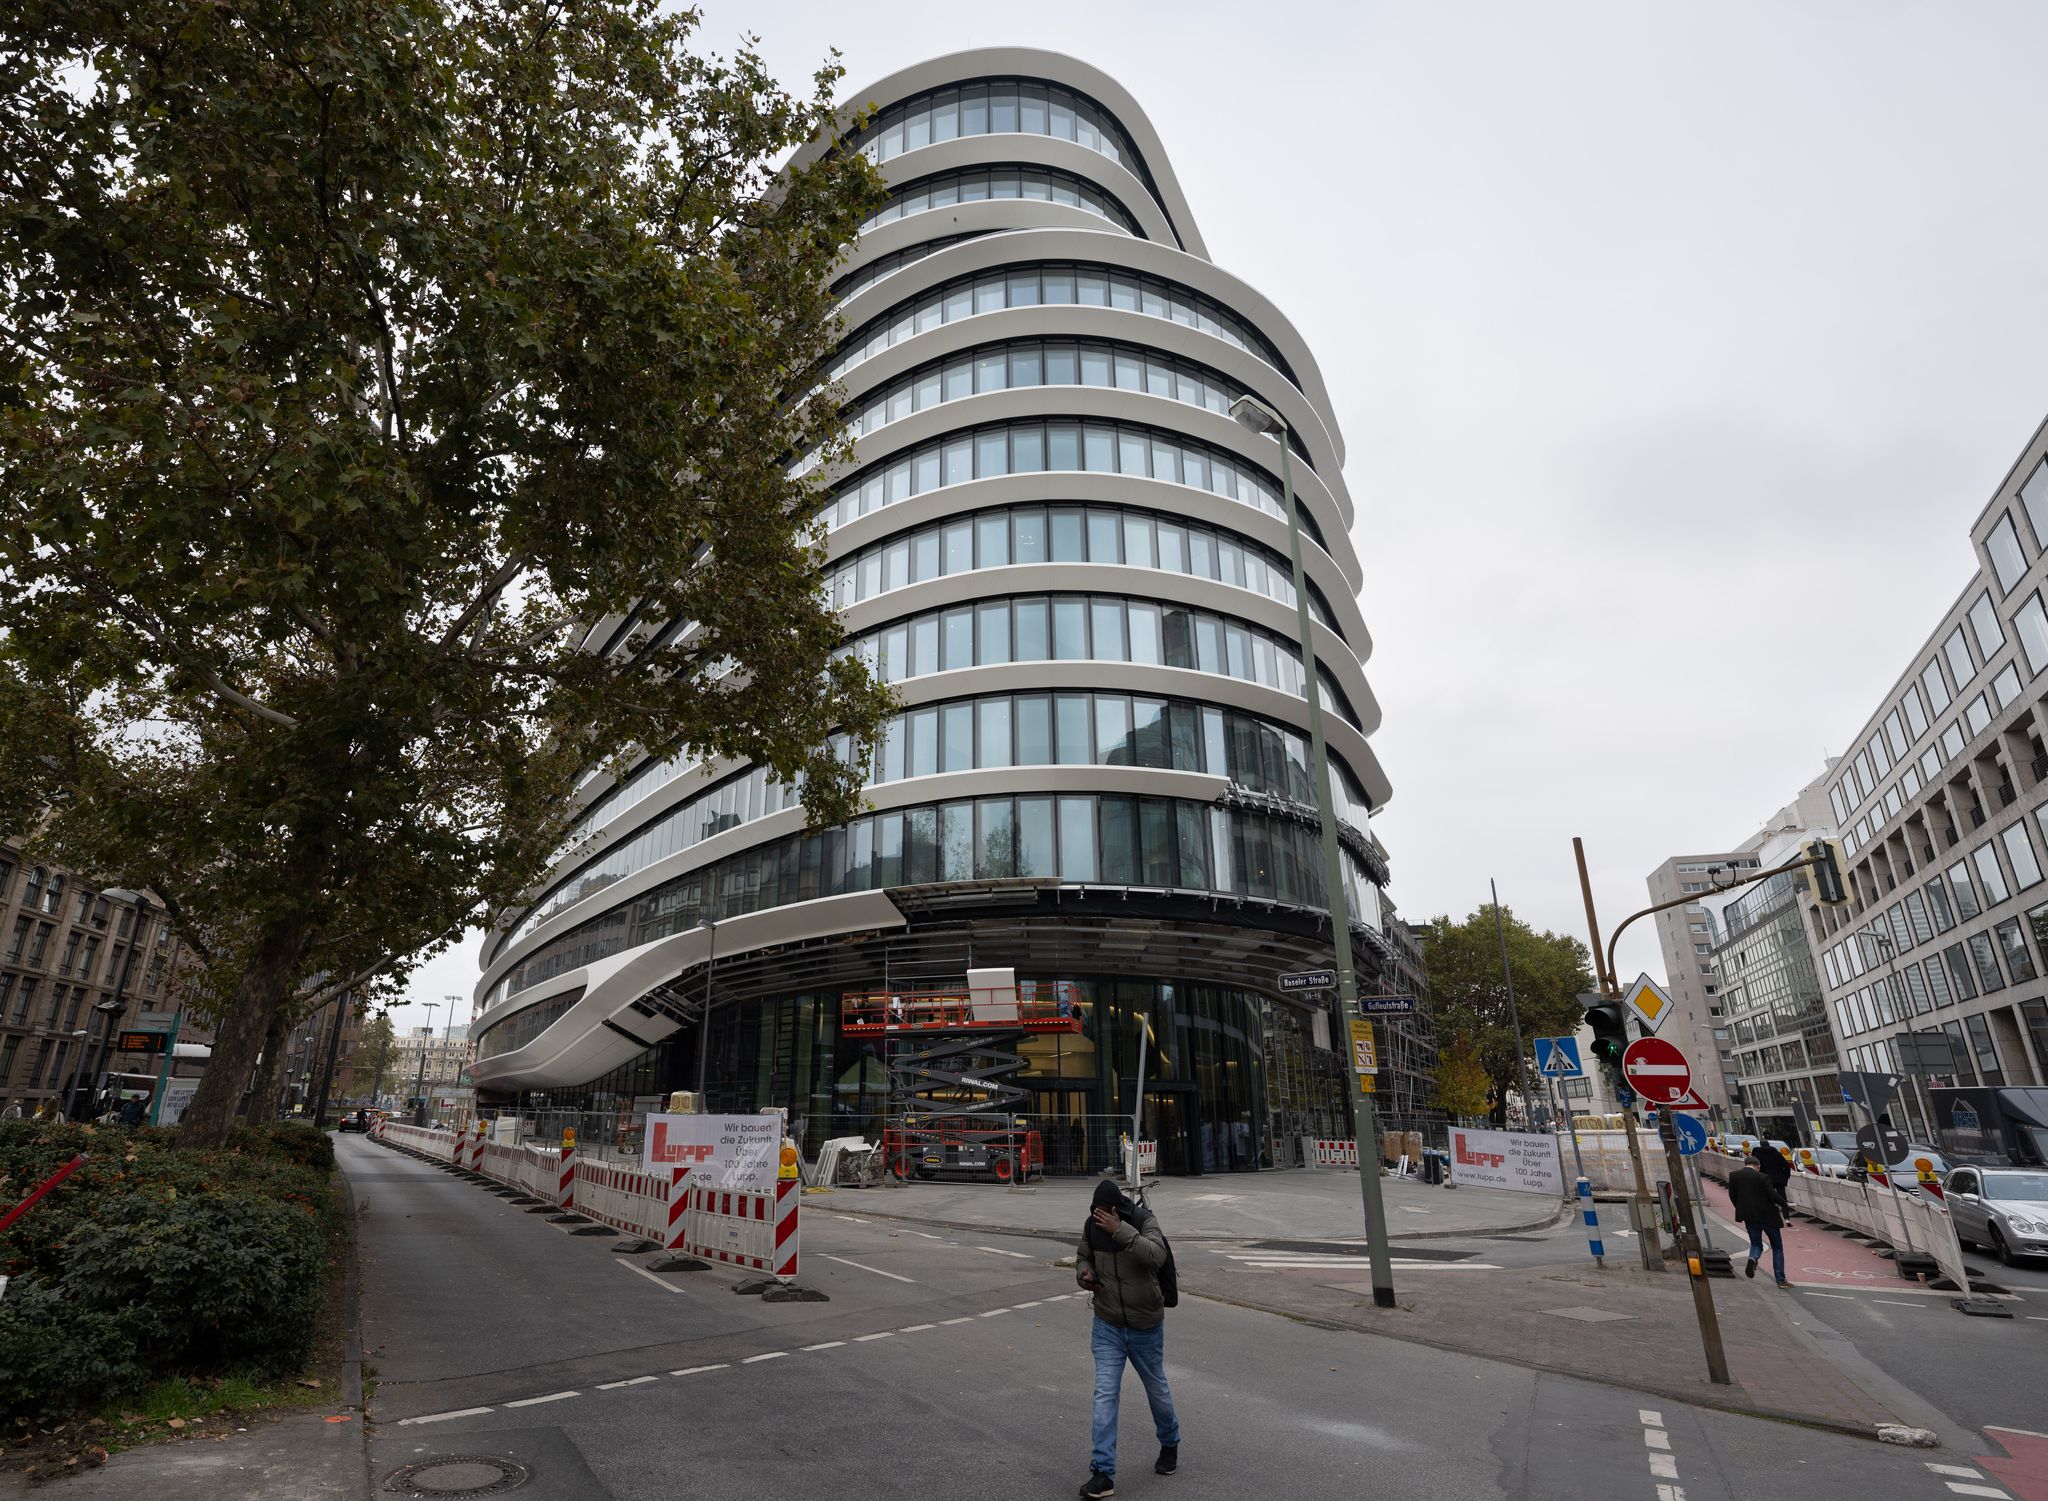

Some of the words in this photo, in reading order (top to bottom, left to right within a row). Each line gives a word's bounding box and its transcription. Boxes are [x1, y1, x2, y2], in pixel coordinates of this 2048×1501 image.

[1284, 977, 1307, 987] Baseler
[1308, 975, 1329, 985] Straße
[1367, 1000, 1409, 1011] Gutleutstraße
[961, 1076, 998, 1090] RIWAL.COM
[724, 1123, 738, 1132] Wir
[741, 1123, 772, 1132] bauen
[720, 1135, 735, 1145] die
[1510, 1138, 1522, 1147] Wir
[1524, 1139, 1550, 1149] bauen
[735, 1146, 759, 1157] Über
[1508, 1148, 1521, 1156] die
[1523, 1149, 1554, 1158] Zukunft.
[724, 1159, 740, 1169] 100
[742, 1159, 769, 1169] Jahre
[1522, 1157, 1541, 1167] Über
[732, 1172, 758, 1182] Lupp.
[1457, 1171, 1507, 1183] www.lupp.de
[1515, 1167, 1528, 1176] 100
[1529, 1168, 1552, 1178] Jahre
[1523, 1178, 1545, 1188] Lupp.
